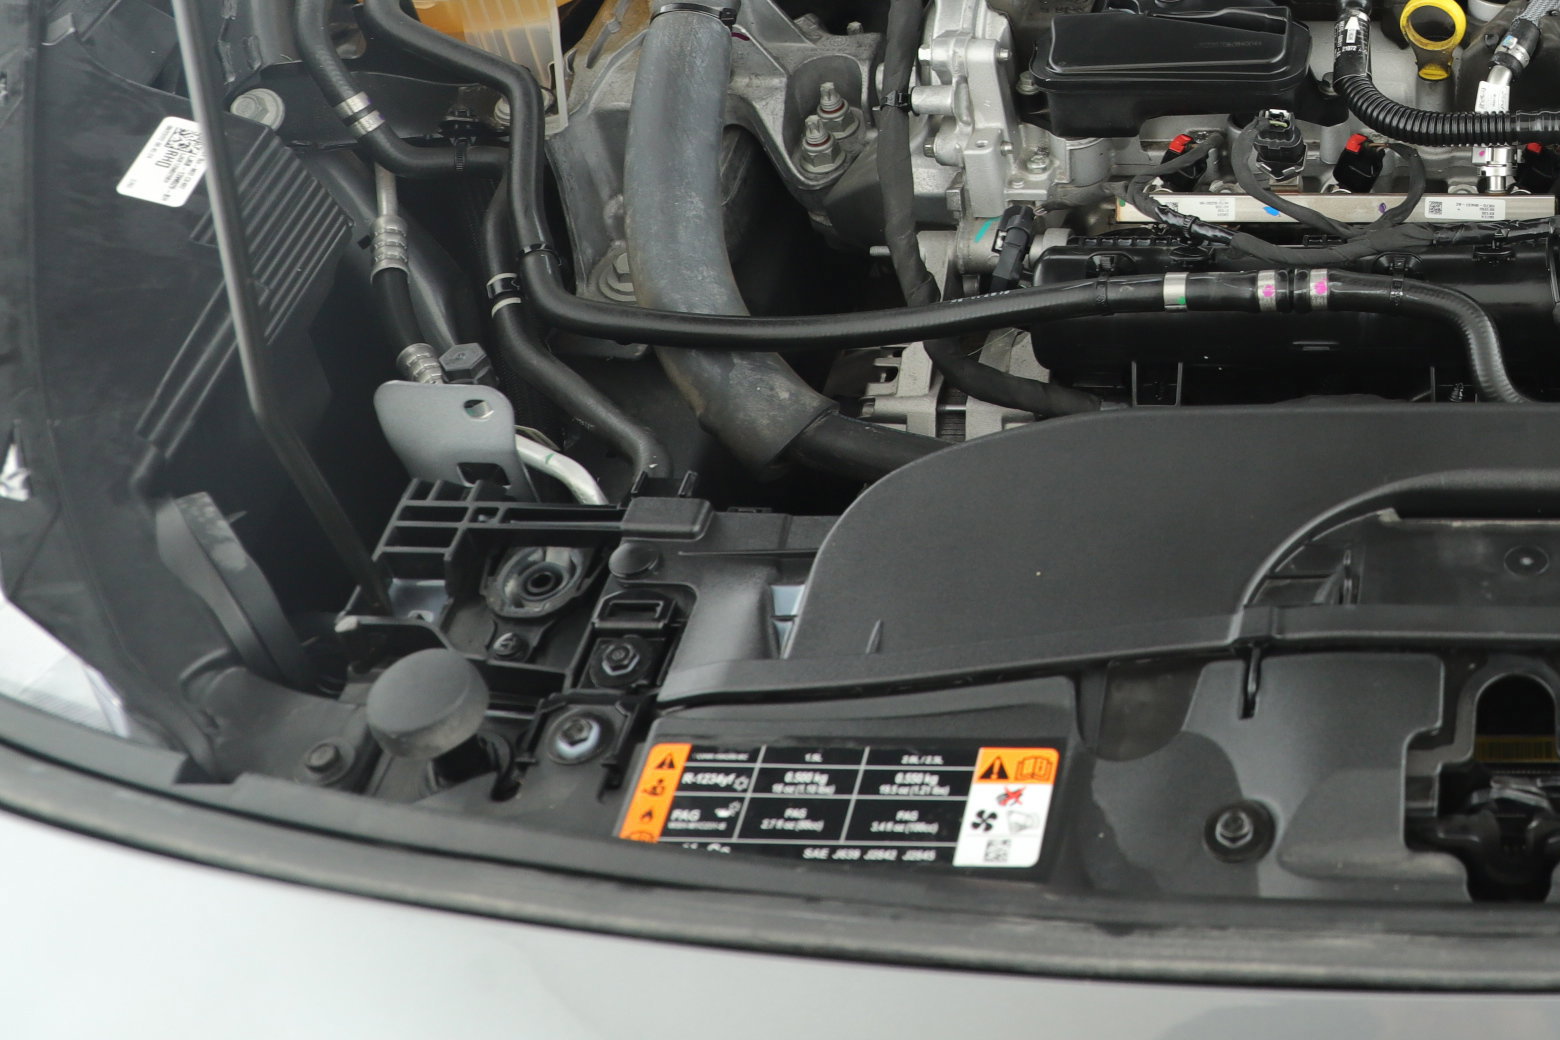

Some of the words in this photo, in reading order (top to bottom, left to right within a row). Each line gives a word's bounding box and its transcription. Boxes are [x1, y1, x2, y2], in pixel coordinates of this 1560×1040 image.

[681, 771, 736, 788] R-1234yf
[813, 771, 829, 786] kg
[924, 772, 939, 786] kg
[670, 809, 701, 822] PAG
[784, 808, 808, 819] PAG
[895, 810, 919, 821] PAG
[802, 847, 830, 859] SAE
